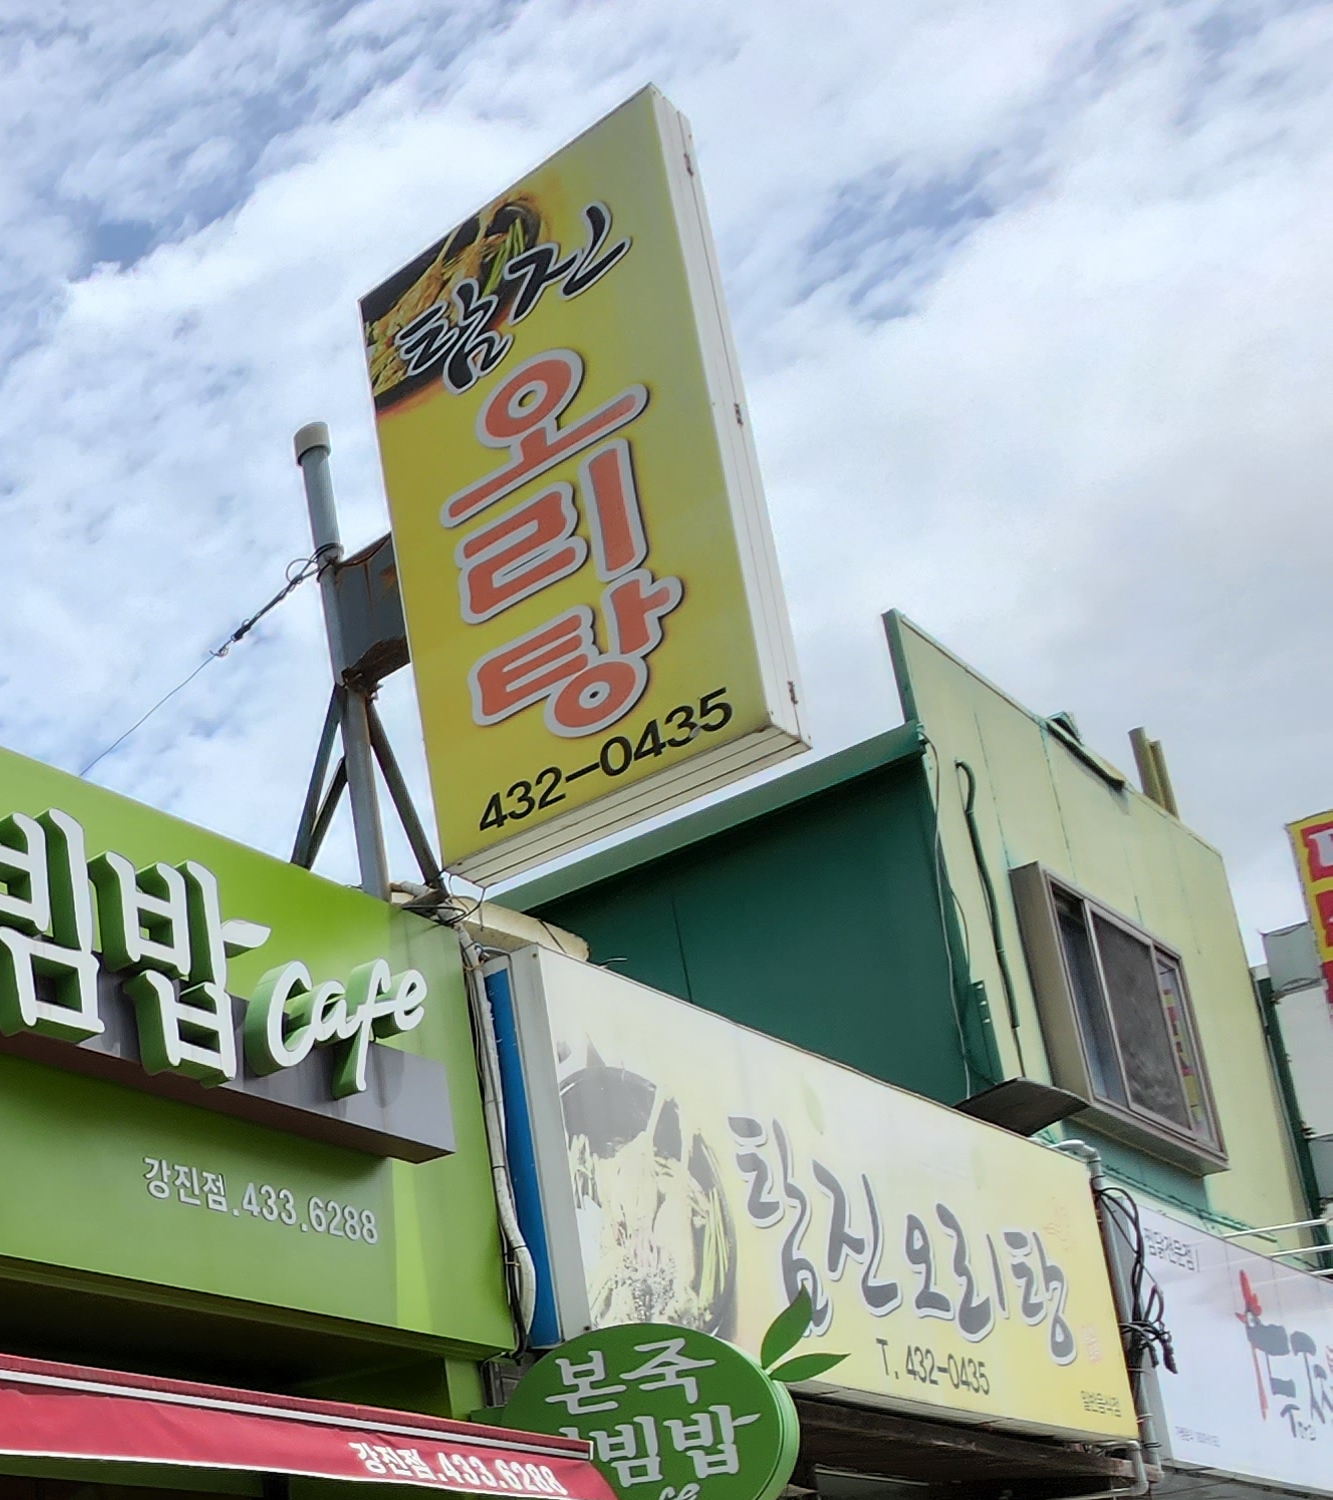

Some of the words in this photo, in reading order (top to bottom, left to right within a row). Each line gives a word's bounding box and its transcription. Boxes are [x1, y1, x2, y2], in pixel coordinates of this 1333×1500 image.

[440, 347, 683, 738] 오리탕
[478, 686, 733, 833] 432-0435
[545, 1336, 716, 1415] 본죽
[905, 1347, 991, 1397] 432-0435
[560, 1405, 762, 1488] 빔밥
